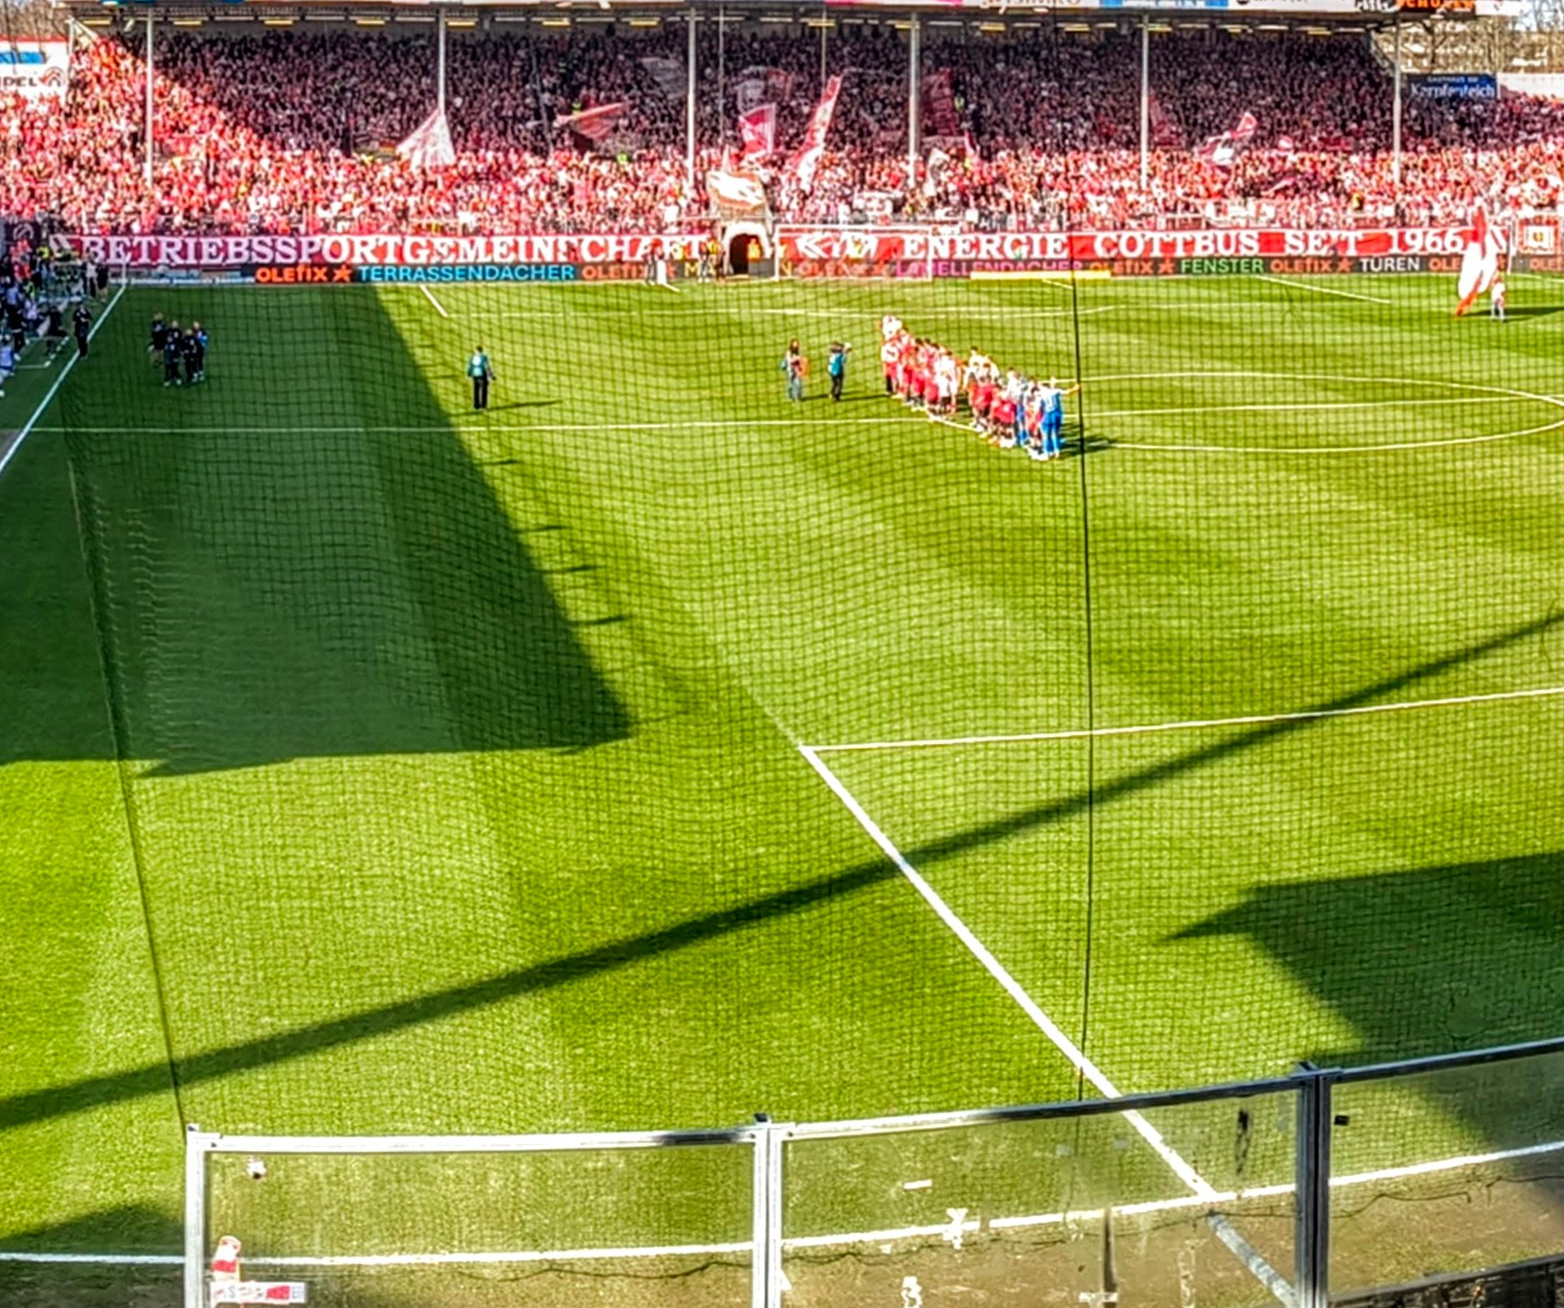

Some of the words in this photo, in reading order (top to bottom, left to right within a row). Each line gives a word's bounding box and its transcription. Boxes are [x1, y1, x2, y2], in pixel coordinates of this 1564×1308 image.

[902, 233, 1068, 260] ENERGIE
[1095, 231, 1260, 258] COTTBUS
[1284, 231, 1365, 257] SEIT
[1387, 229, 1465, 256] 1966
[1180, 258, 1264, 274] FENSTER
